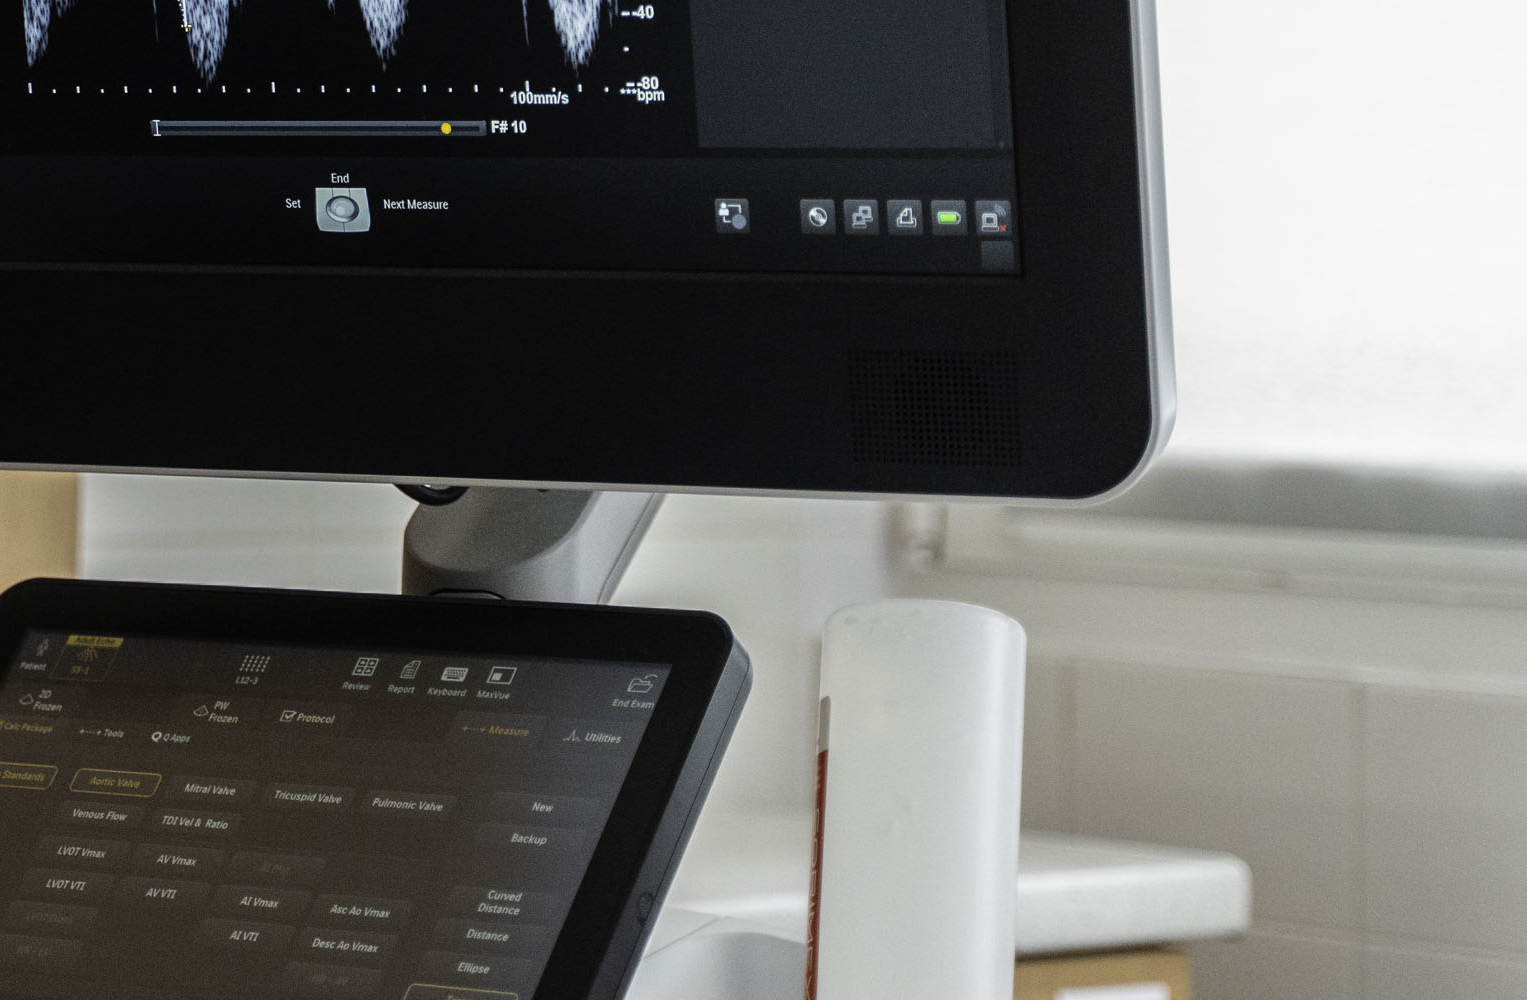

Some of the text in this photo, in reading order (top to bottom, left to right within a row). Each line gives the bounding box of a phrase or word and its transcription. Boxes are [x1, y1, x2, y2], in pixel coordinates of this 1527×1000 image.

[510, 92, 569, 106] 100mm/s
[491, 120, 527, 134] F# 10
[331, 172, 349, 184] End
[285, 198, 301, 209] Set
[383, 199, 449, 210] Next Measure
[342, 681, 371, 692] Review
[387, 684, 415, 695] Report
[427, 687, 467, 698] Keyboard
[476, 690, 511, 700] MaxVue
[33, 702, 63, 712] Frozen
[612, 698, 656, 709] End Exam
[208, 714, 239, 724] Frozen
[297, 713, 335, 724] Protocol
[103, 728, 124, 738] Tools
[489, 725, 529, 737] Measure
[585, 732, 622, 744] Utilities
[91, 776, 141, 789] Aortic Valve
[185, 783, 236, 796] Mitral Valve
[274, 790, 343, 804] Tricuspid Valve
[372, 798, 443, 812] Pulmonic Valve
[531, 802, 554, 813] New
[73, 808, 128, 822] Venous Flow
[161, 816, 229, 830] TDI Vel Ratio
[511, 833, 547, 846] Backup
[57, 846, 107, 859] LVOT Vmax
[157, 854, 197, 867] AV Vmax
[46, 878, 86, 891] LVOT VTI
[145, 888, 177, 900] AV VTI
[487, 890, 523, 902] Curved
[253, 898, 279, 909] Vmax
[477, 902, 521, 916] Distance
[330, 904, 391, 918] Asc Ao Vmax
[243, 931, 260, 942] VTI
[467, 928, 509, 942] Distance
[312, 938, 379, 953] Desc Ao Vmax
[457, 962, 490, 974] Ellipse
